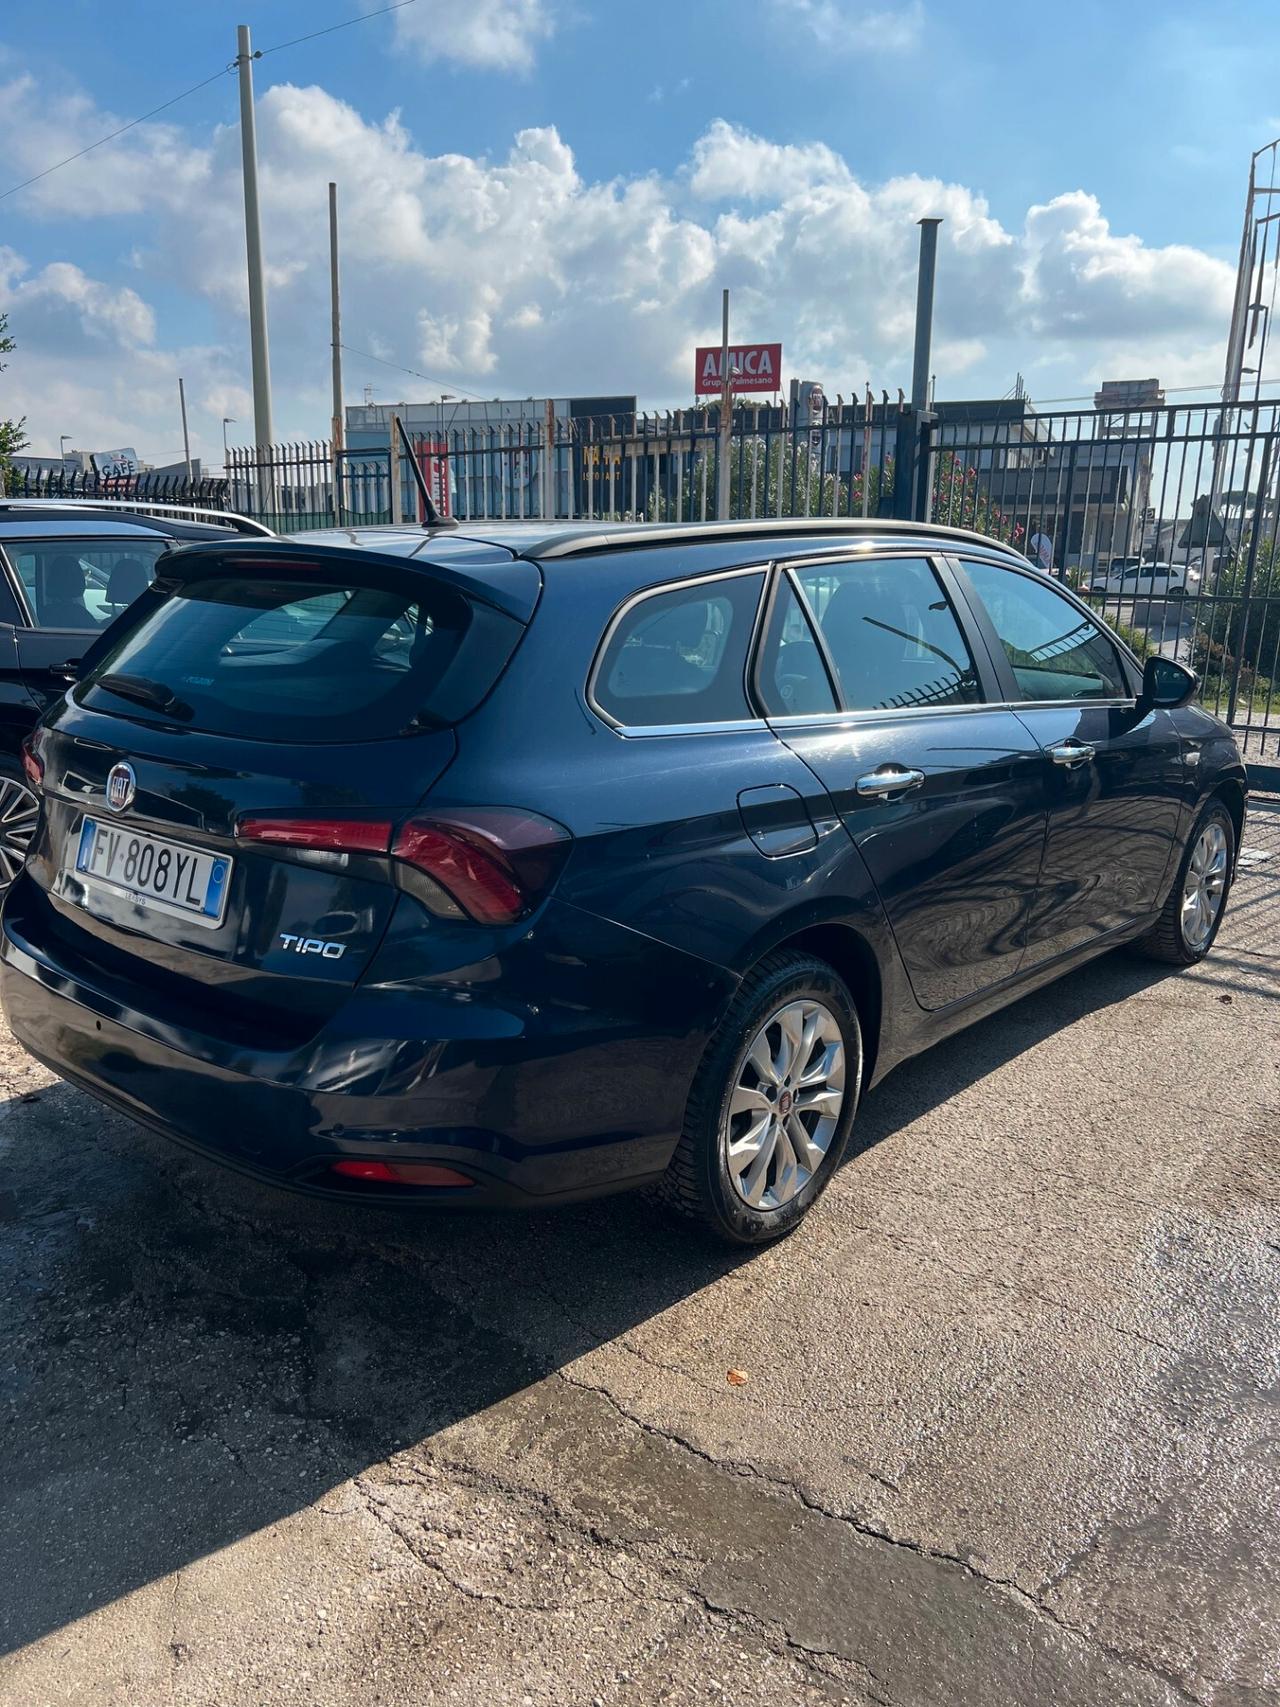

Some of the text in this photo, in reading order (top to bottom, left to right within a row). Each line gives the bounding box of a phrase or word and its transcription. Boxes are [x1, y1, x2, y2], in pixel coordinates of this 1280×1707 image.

[702, 377, 772, 387] Grup Palmesano
[111, 776, 129, 799] FIAT
[280, 933, 348, 959] TIPO
